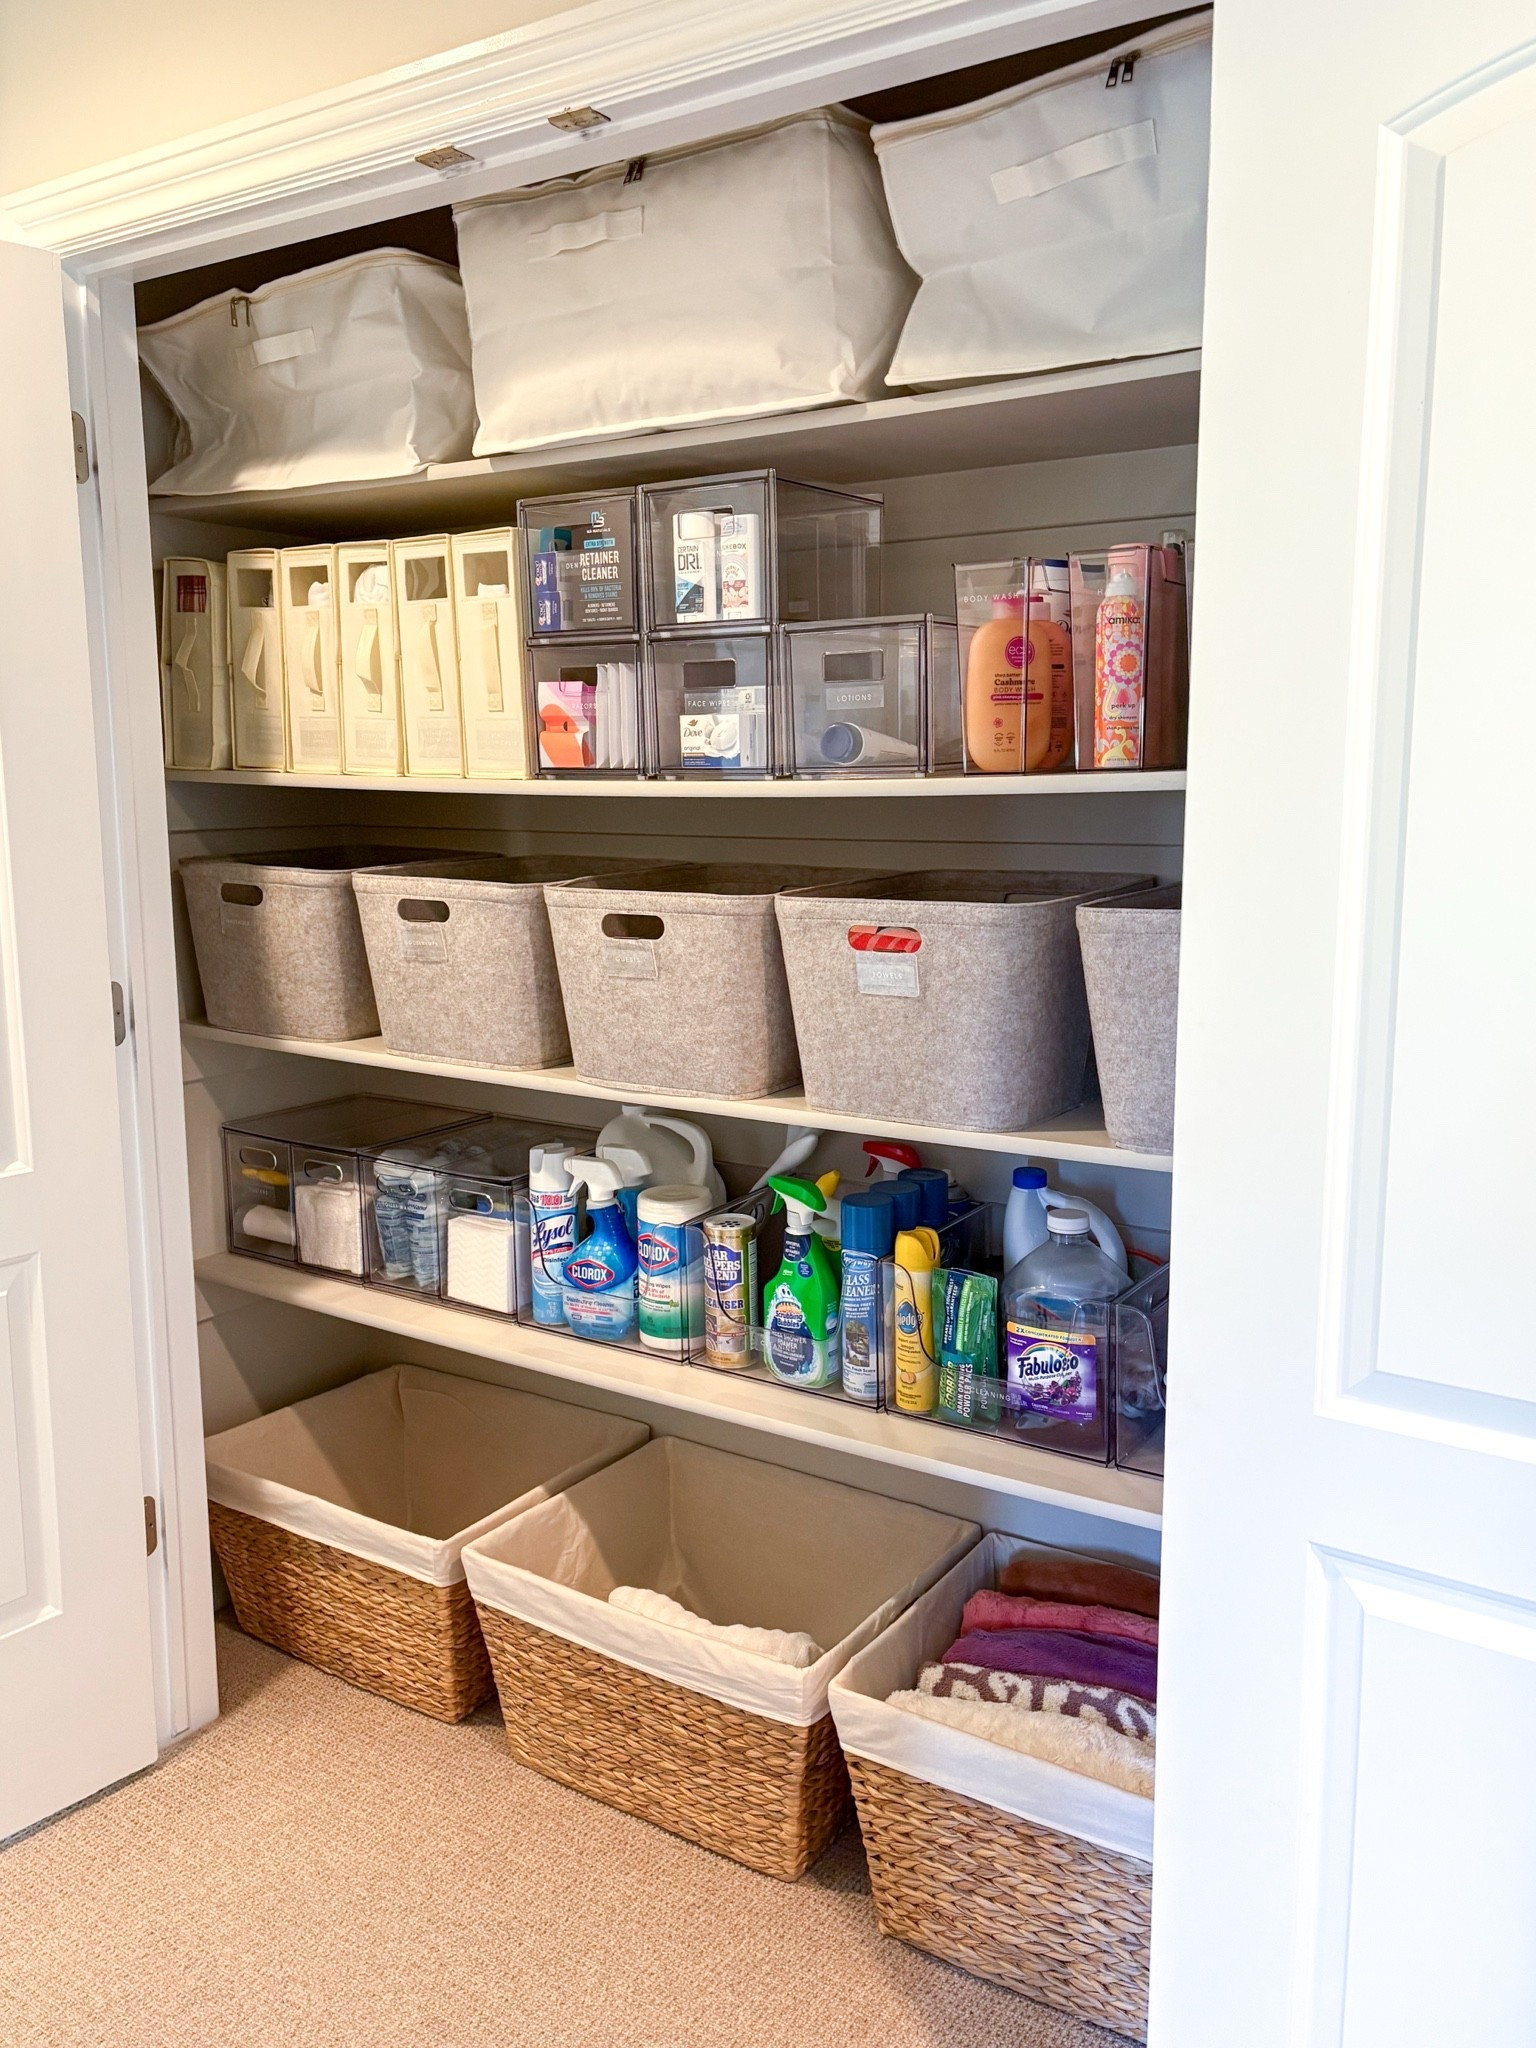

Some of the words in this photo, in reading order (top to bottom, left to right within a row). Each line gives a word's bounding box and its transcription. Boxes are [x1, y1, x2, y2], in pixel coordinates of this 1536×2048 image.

[678, 545, 699, 554] CERTAIN
[580, 550, 620, 566] RETAINER
[582, 566, 618, 581] CLEANER
[964, 594, 988, 603] BODY
[992, 592, 1019, 600] WASH
[836, 694, 872, 702] LOTIONS
[683, 728, 702, 737] Dove
[532, 1215, 573, 1249] Lysol
[572, 1264, 607, 1282] CLOROX
[945, 1278, 955, 1305] TOUGHEST
[776, 1310, 803, 1322] Scrubbing
[777, 1318, 800, 1327] Bubbles
[965, 1363, 973, 1383] PACS
[1017, 1354, 1079, 1378] Fabuloso
[945, 1361, 958, 1410] GOBBLER
[963, 1384, 972, 1418] POWDER
[970, 1386, 1011, 1402] CLEANING
